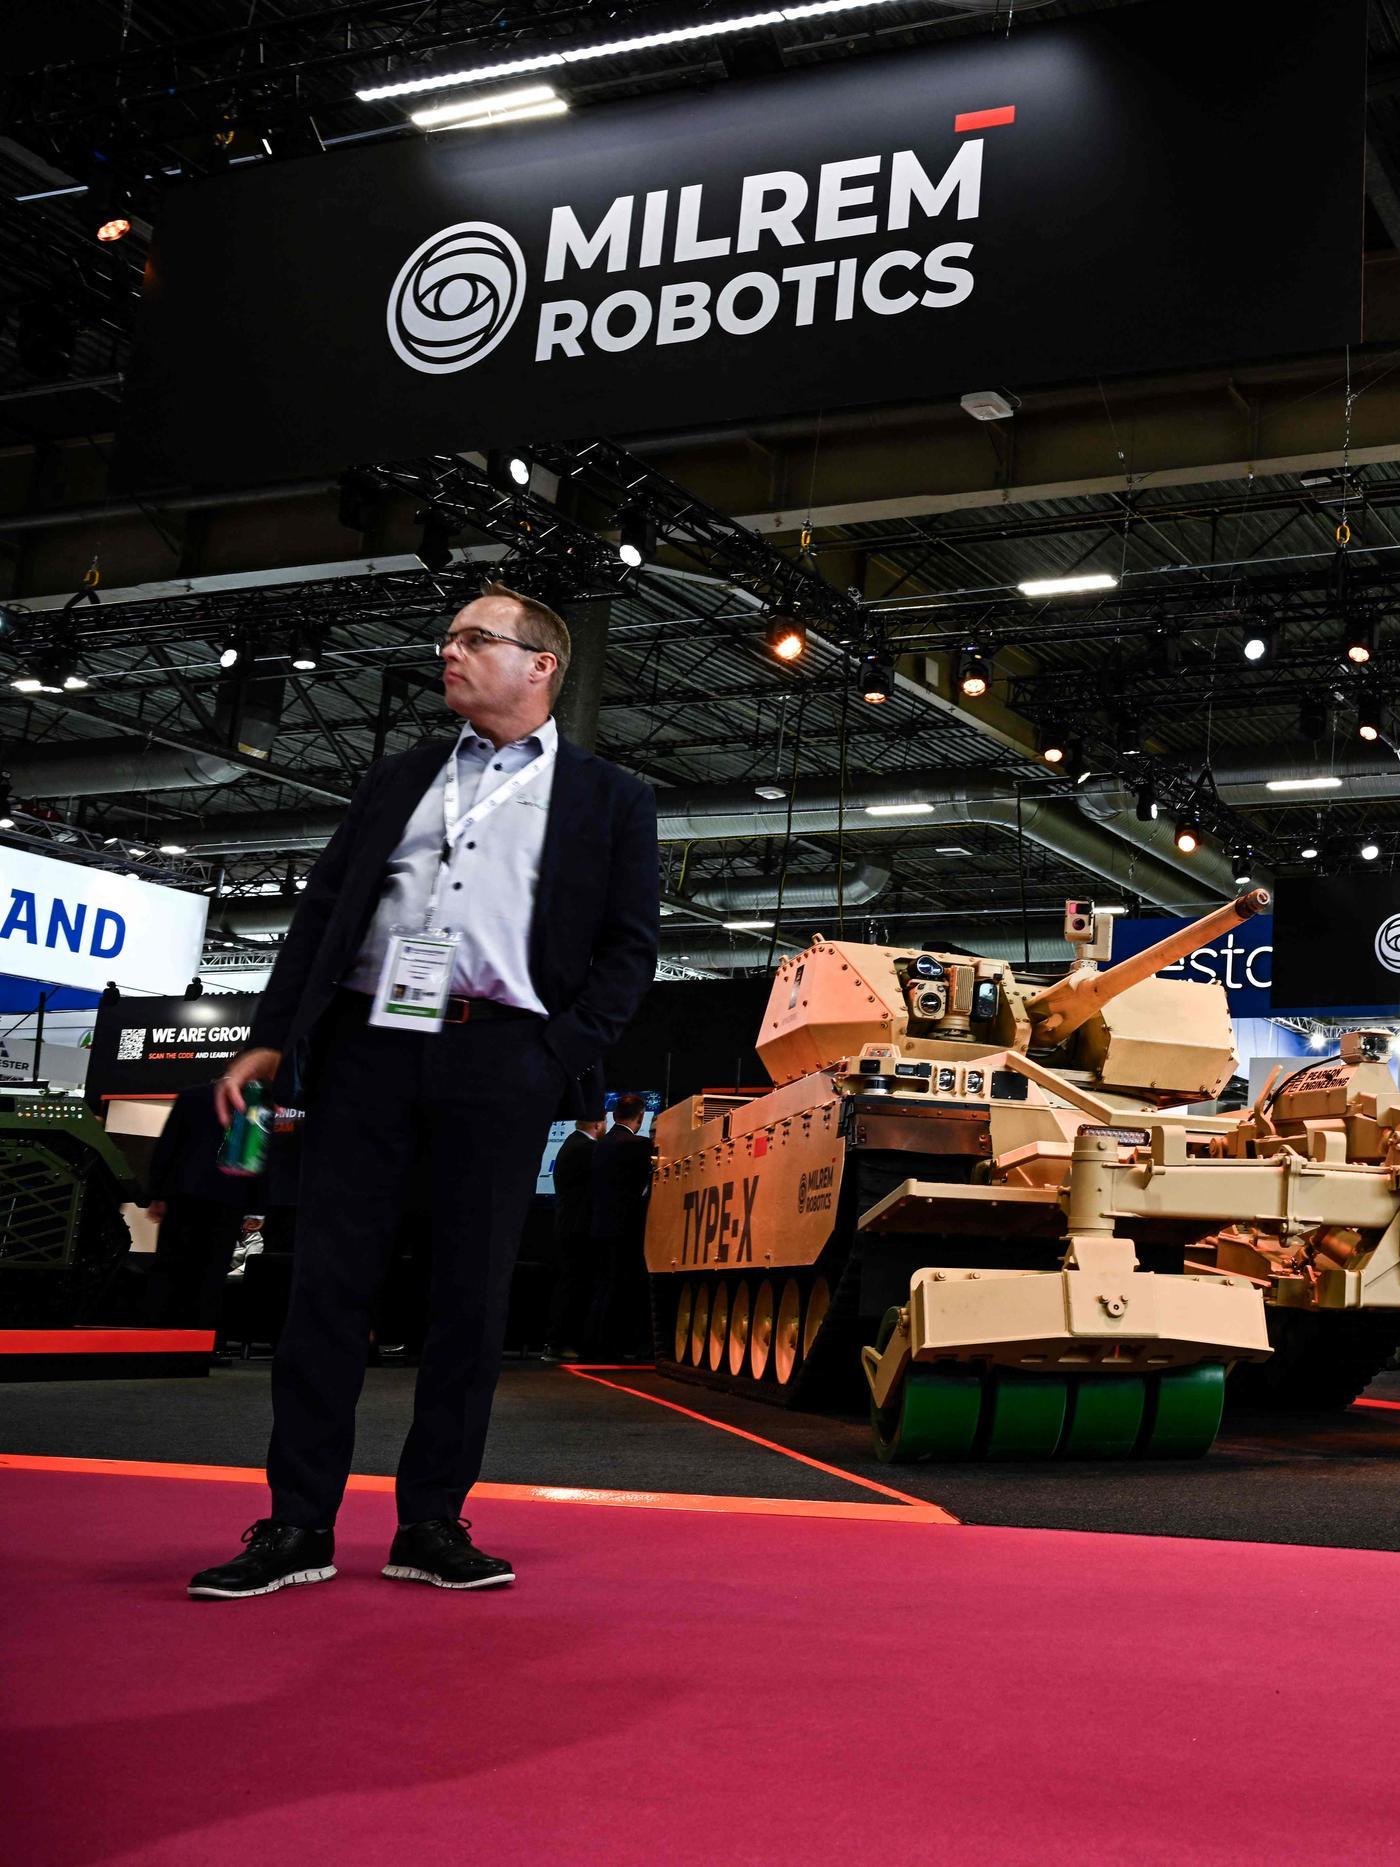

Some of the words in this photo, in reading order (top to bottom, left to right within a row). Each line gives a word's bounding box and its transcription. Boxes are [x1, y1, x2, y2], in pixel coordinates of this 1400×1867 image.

[544, 138, 985, 283] MILREM
[535, 242, 975, 363] ROBOTICS
[0, 888, 126, 959] AND
[152, 1028, 176, 1043] WE
[179, 1028, 205, 1043] ARE
[209, 1051, 229, 1059] LEARN
[1298, 1077, 1350, 1091] ENGINEERING
[808, 1166, 834, 1189] MILREM
[805, 1193, 832, 1213] ROBOTICS
[682, 1175, 760, 1265] TYPE-X
